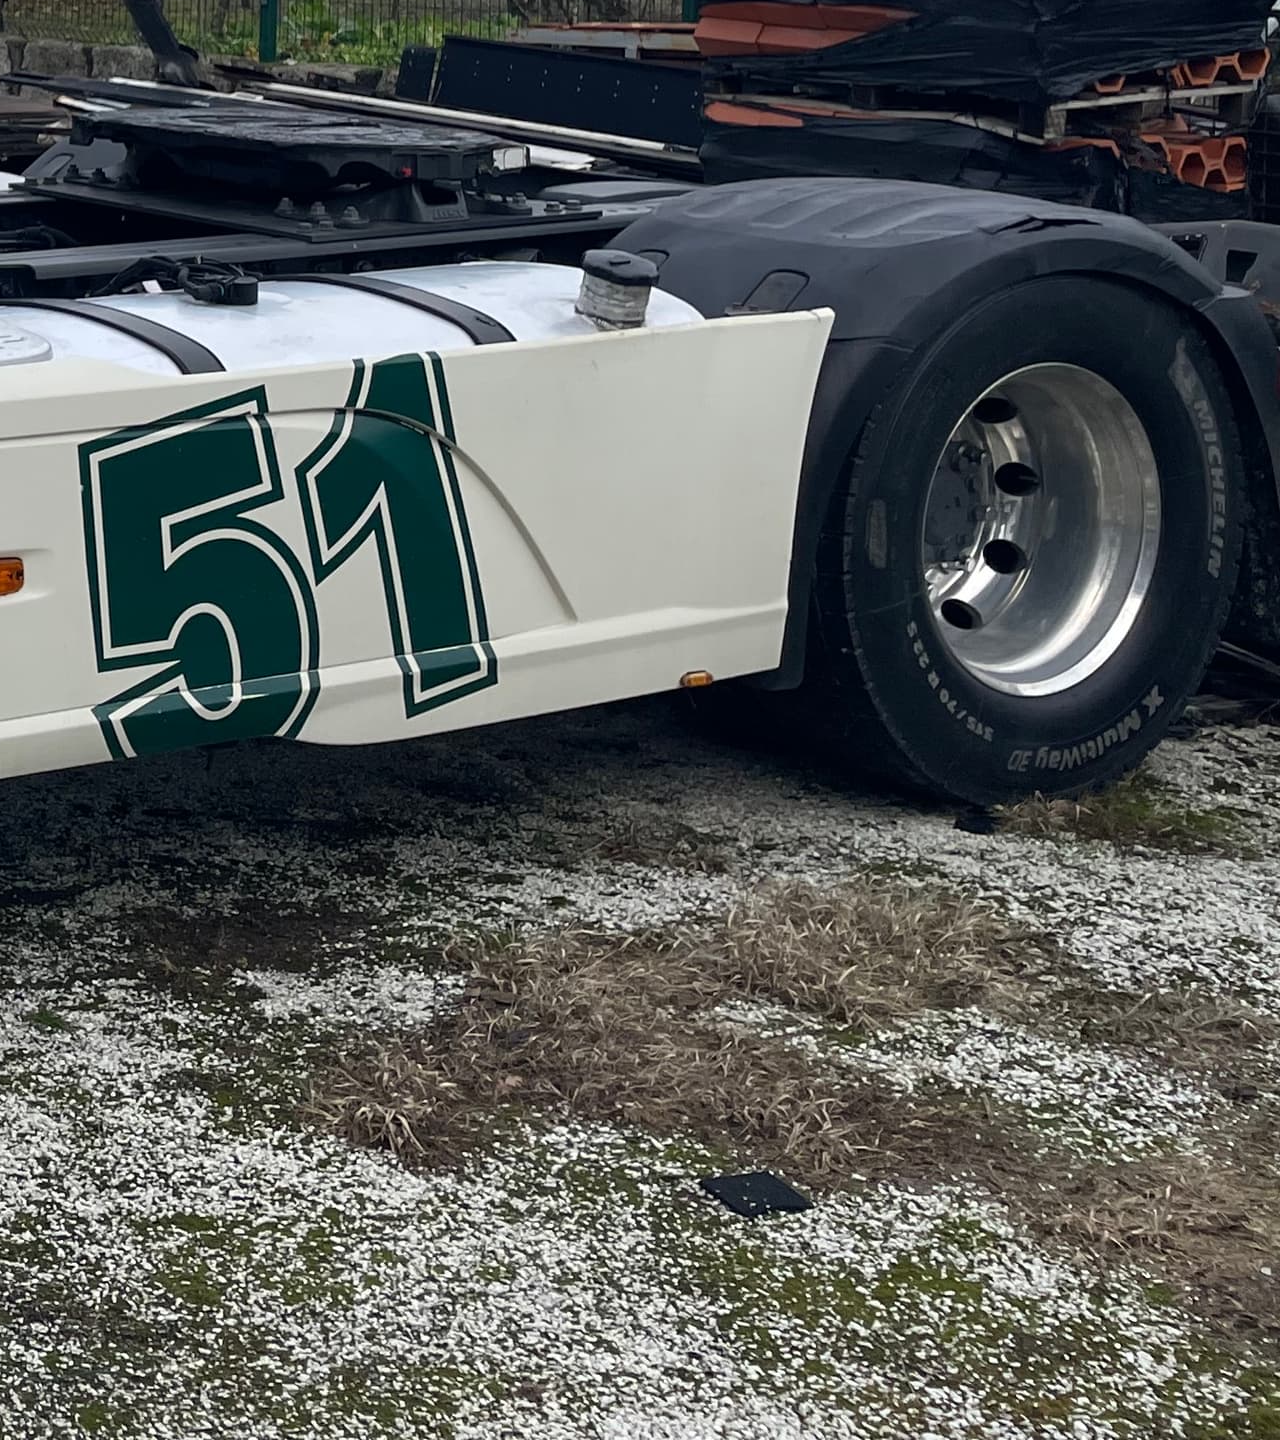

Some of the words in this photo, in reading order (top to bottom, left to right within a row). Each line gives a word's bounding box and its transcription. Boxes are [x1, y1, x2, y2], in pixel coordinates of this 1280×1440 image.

[1193, 399, 1227, 579] MICHELIN
[77, 351, 498, 761] 51
[1142, 684, 1165, 717] X
[1007, 749, 1032, 772] 3D
[1035, 709, 1142, 772] MultiWay
